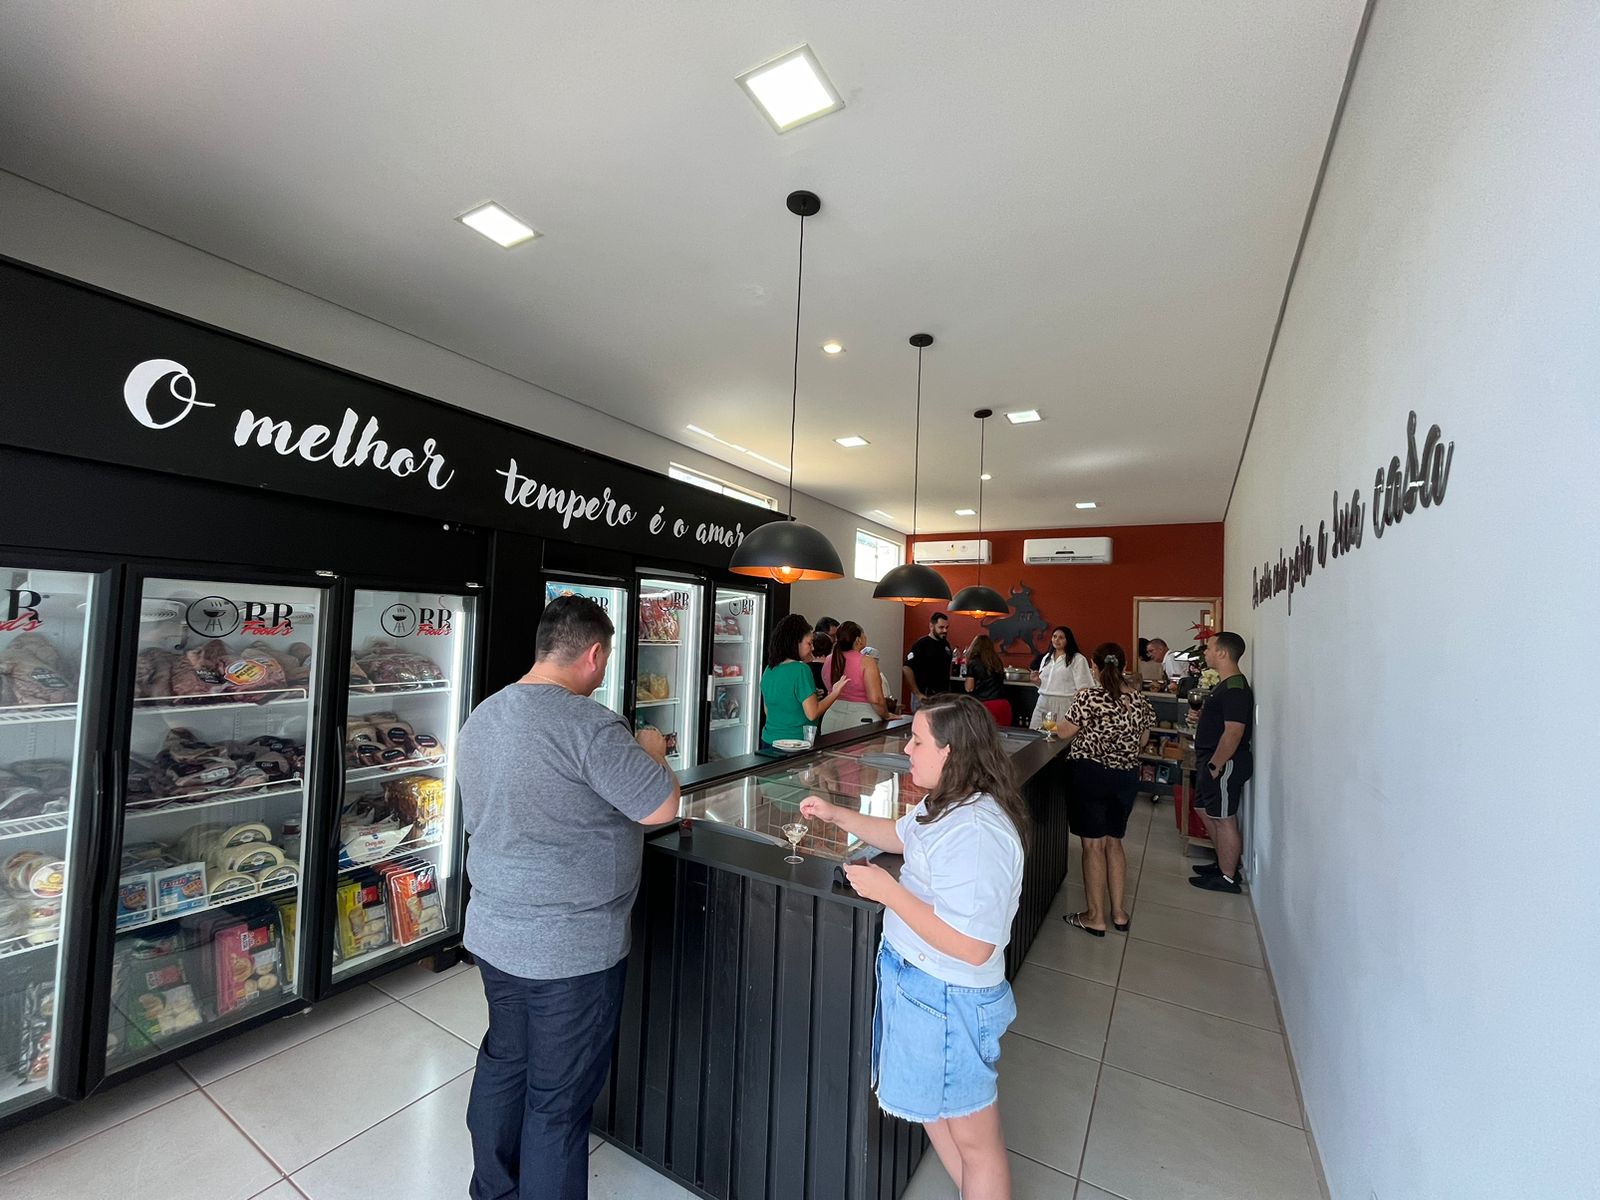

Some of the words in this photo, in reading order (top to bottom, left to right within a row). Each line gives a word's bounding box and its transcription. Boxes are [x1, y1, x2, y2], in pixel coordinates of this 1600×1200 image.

[123, 358, 216, 430] O
[234, 407, 455, 490] melhor
[496, 458, 637, 529] tempero
[649, 505, 666, 535] é
[673, 518, 689, 538] o
[695, 522, 745, 548] amor
[1317, 519, 1329, 568] a
[1332, 489, 1366, 558] sua
[1373, 409, 1455, 539] casa
